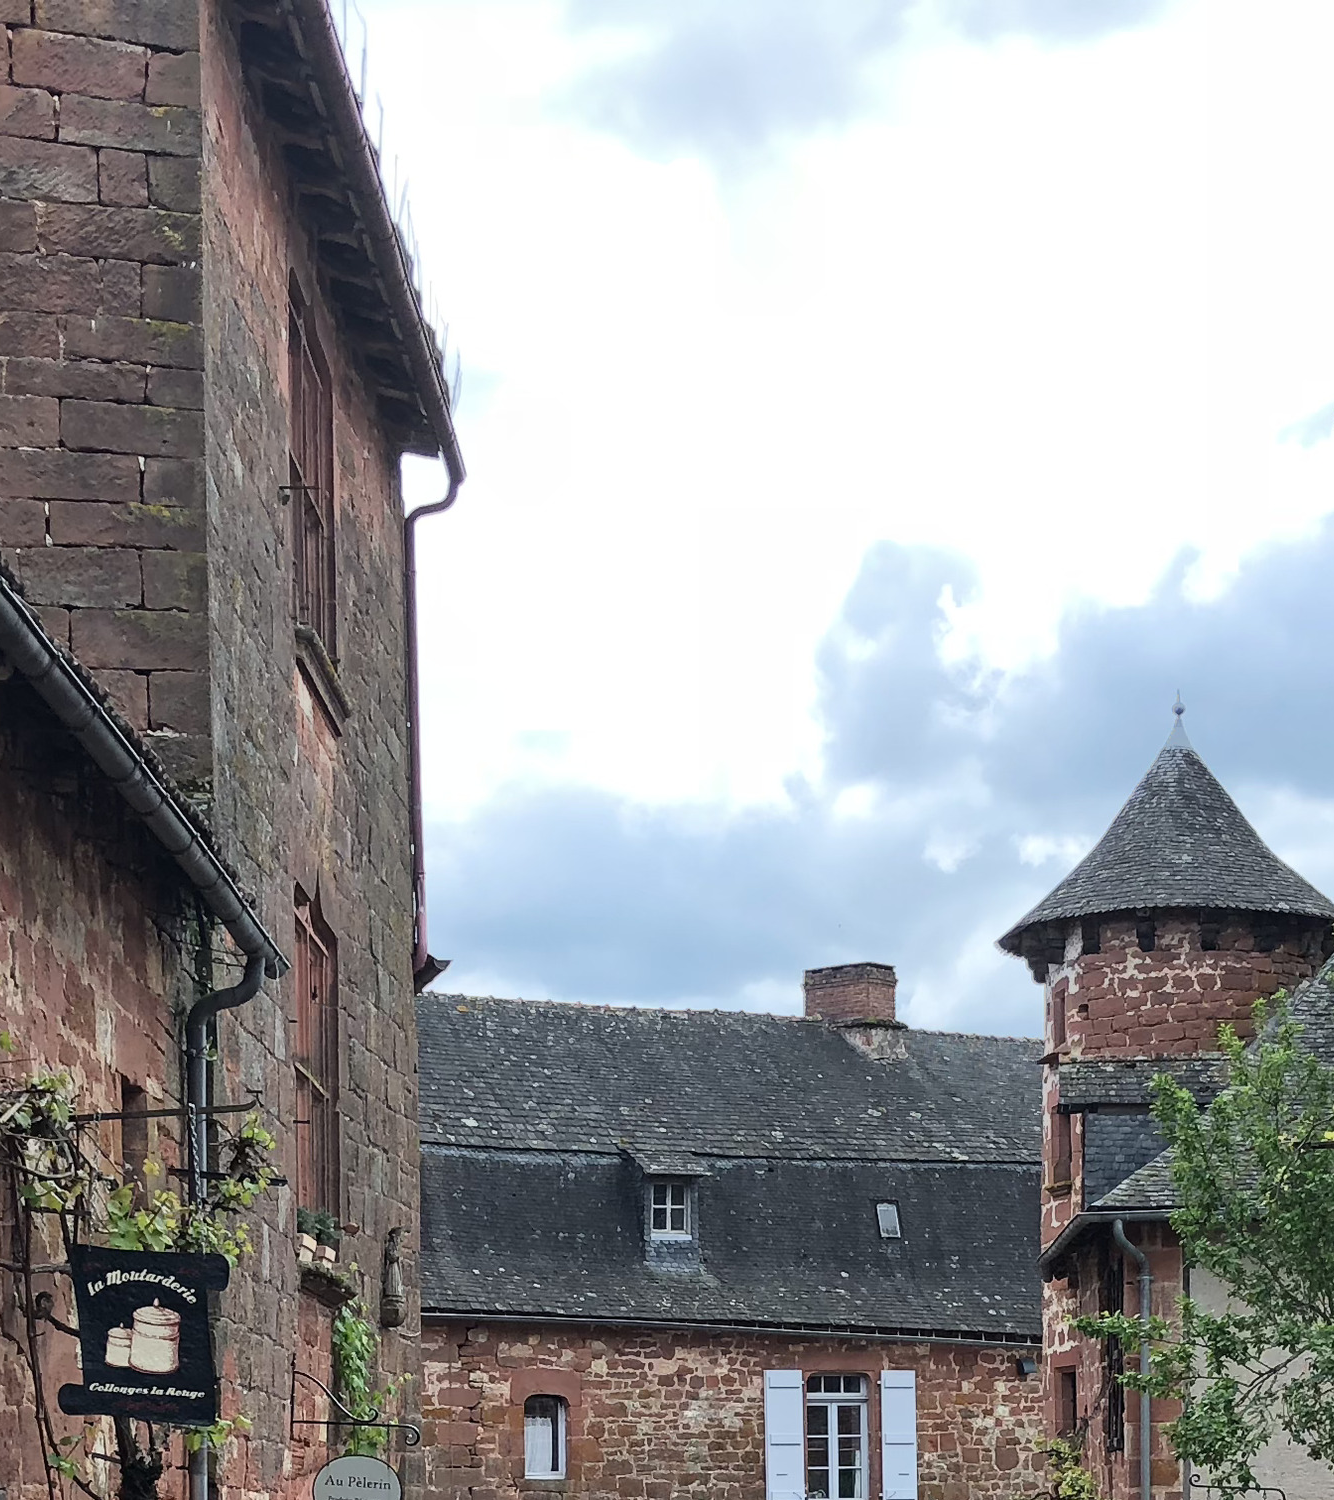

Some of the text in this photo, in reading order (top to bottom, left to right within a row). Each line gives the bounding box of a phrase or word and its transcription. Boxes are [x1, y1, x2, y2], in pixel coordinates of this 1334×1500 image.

[105, 1268, 197, 1304] Moutarderie
[89, 1382, 206, 1400] Collonges la Rouge
[324, 1474, 391, 1490] Au Pèlerin
